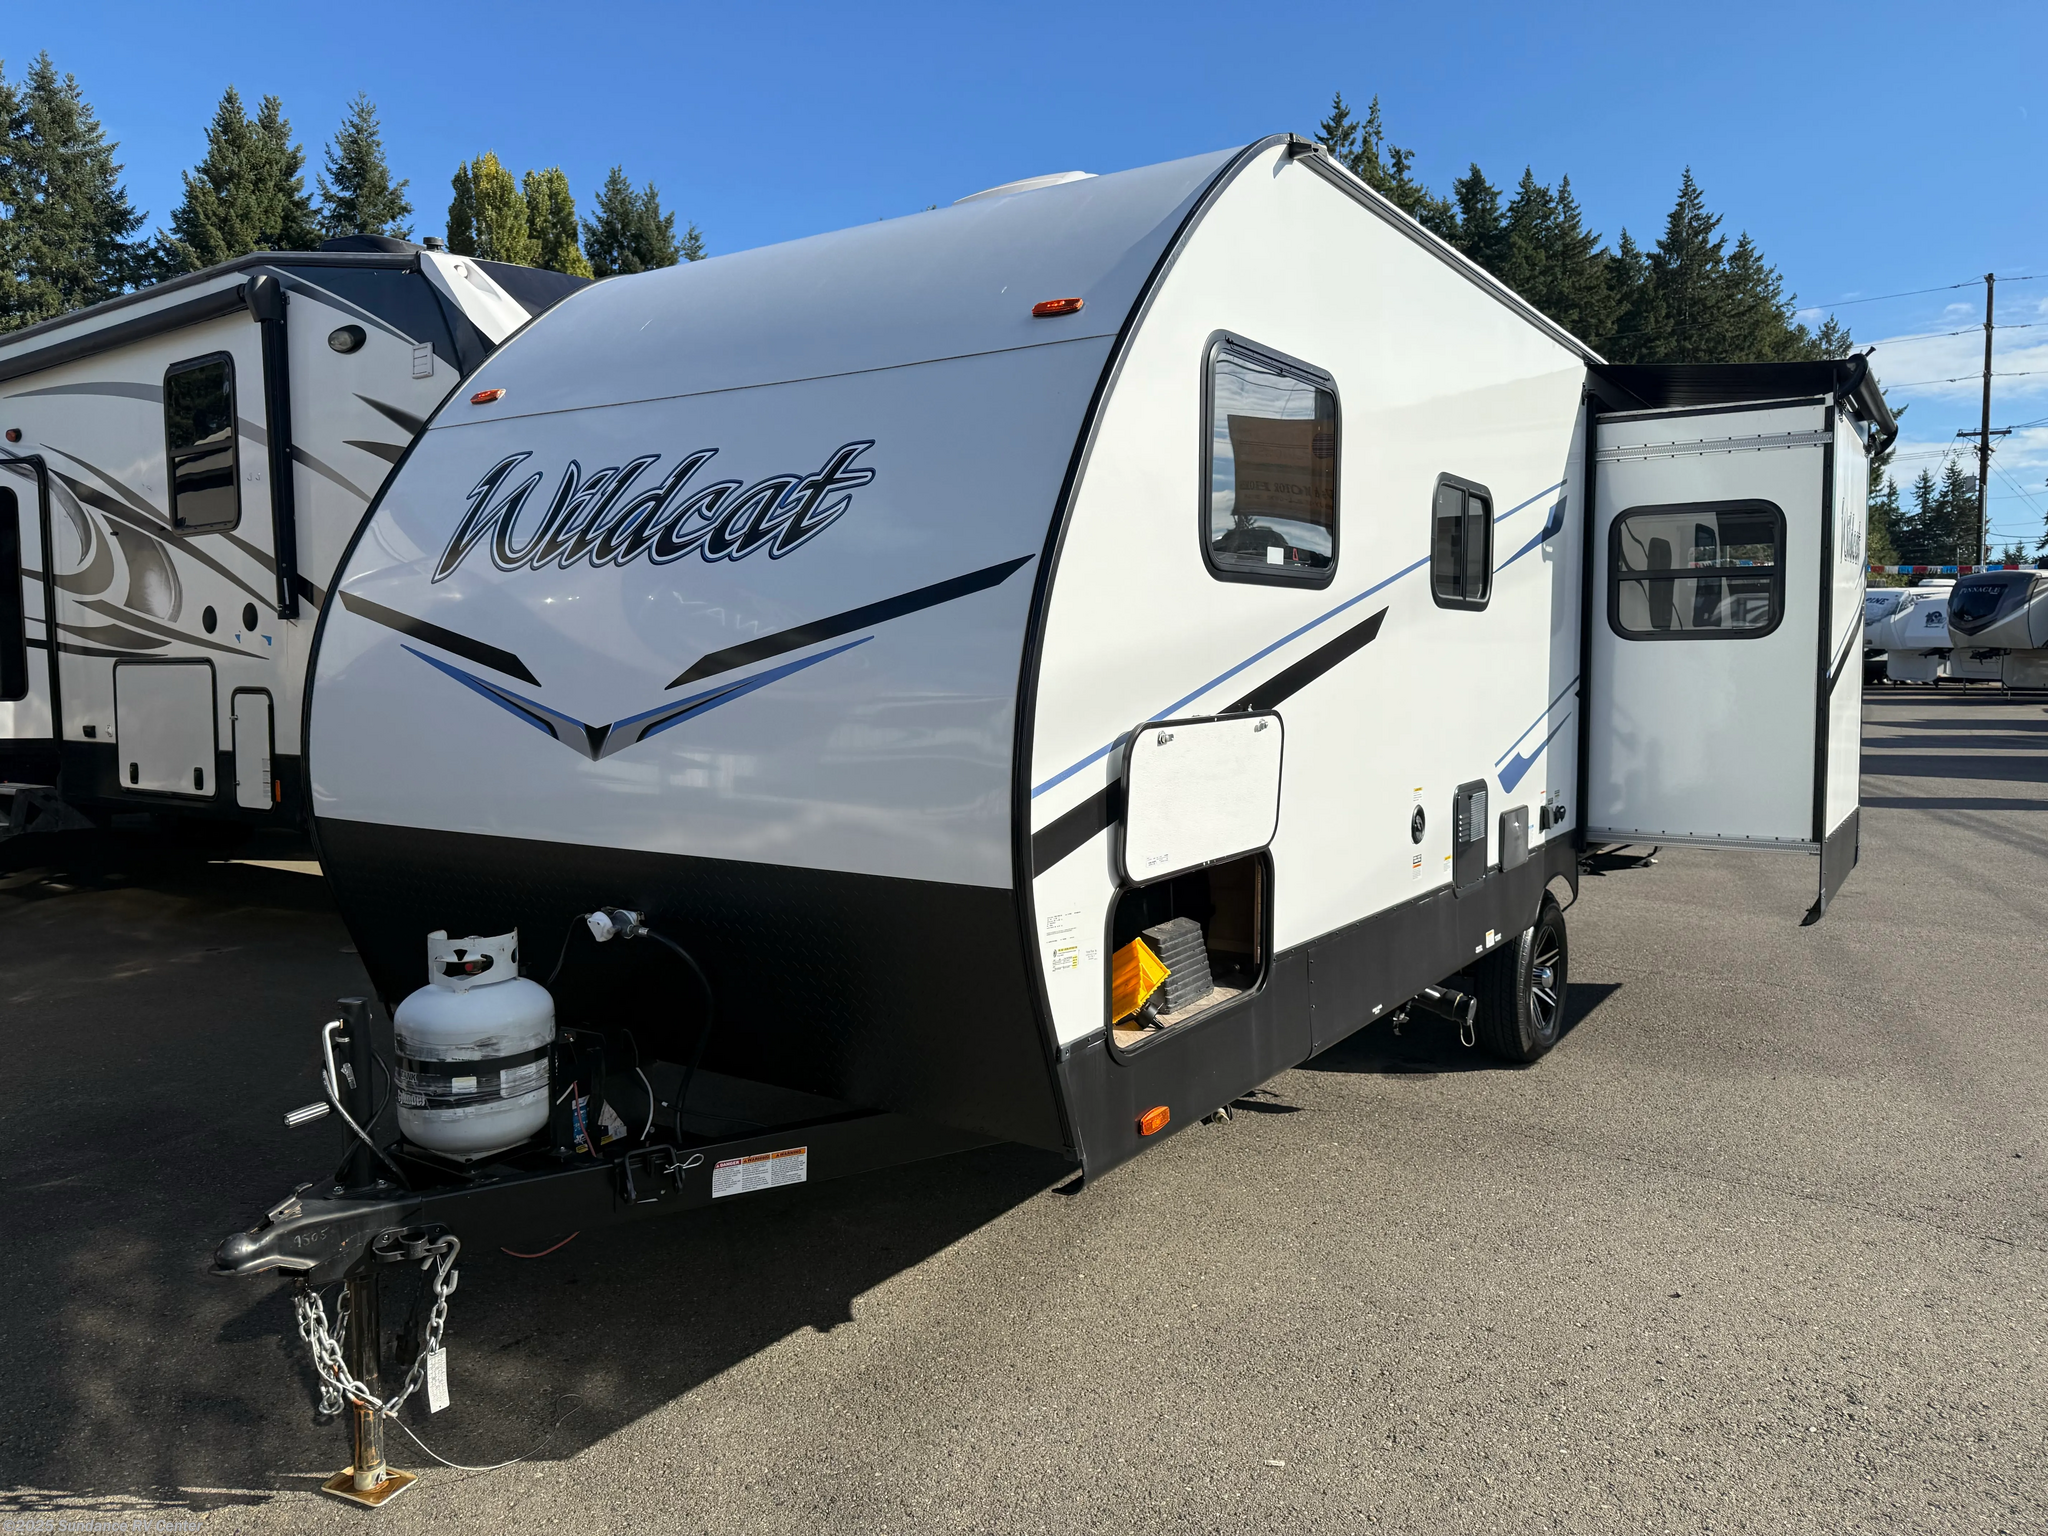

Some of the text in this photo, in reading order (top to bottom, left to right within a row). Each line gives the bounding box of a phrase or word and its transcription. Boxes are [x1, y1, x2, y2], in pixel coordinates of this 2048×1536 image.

[431, 439, 875, 583] Wildcat
[1958, 586, 2001, 595] PINNACLE
[719, 1160, 740, 1168] DANGER
